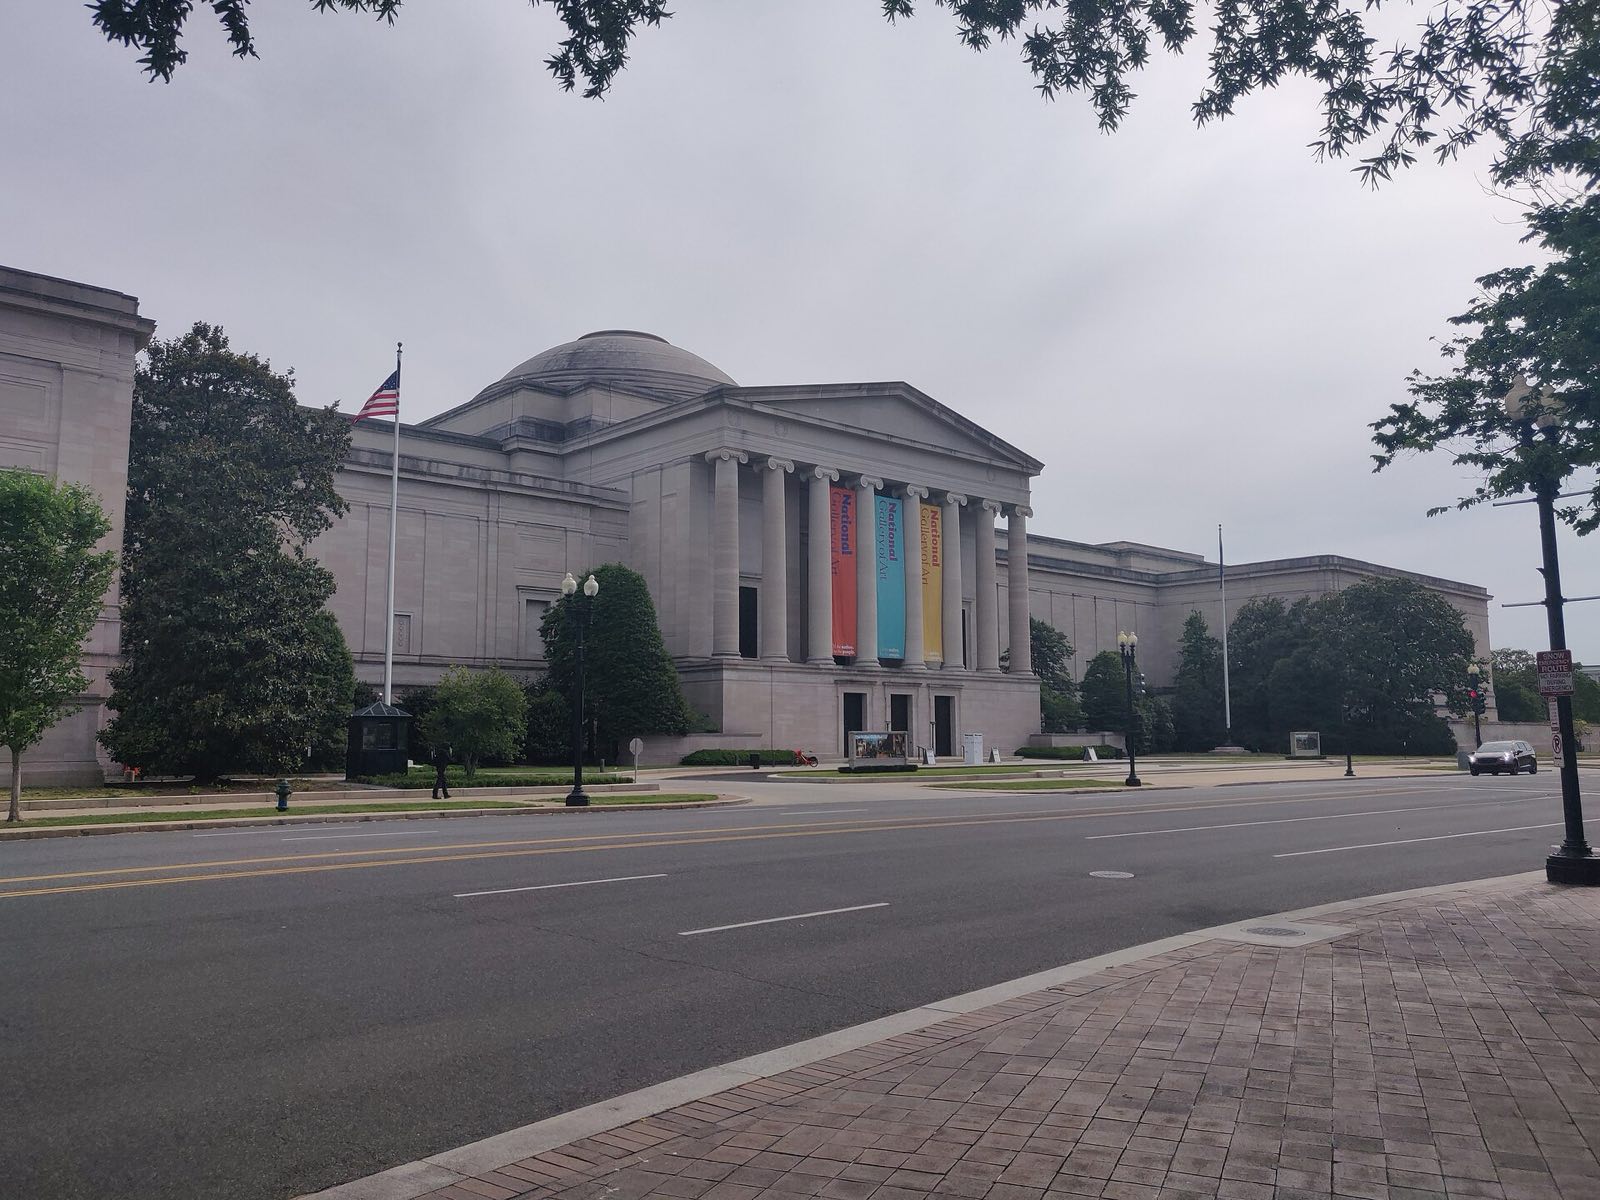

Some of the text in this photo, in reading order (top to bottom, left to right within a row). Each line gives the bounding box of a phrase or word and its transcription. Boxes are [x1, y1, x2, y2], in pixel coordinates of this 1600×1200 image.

[841, 494, 853, 556] National
[877, 500, 887, 546] Gallery
[888, 502, 898, 561] National
[930, 509, 940, 567] National
[1542, 652, 1565, 660] SNOW
